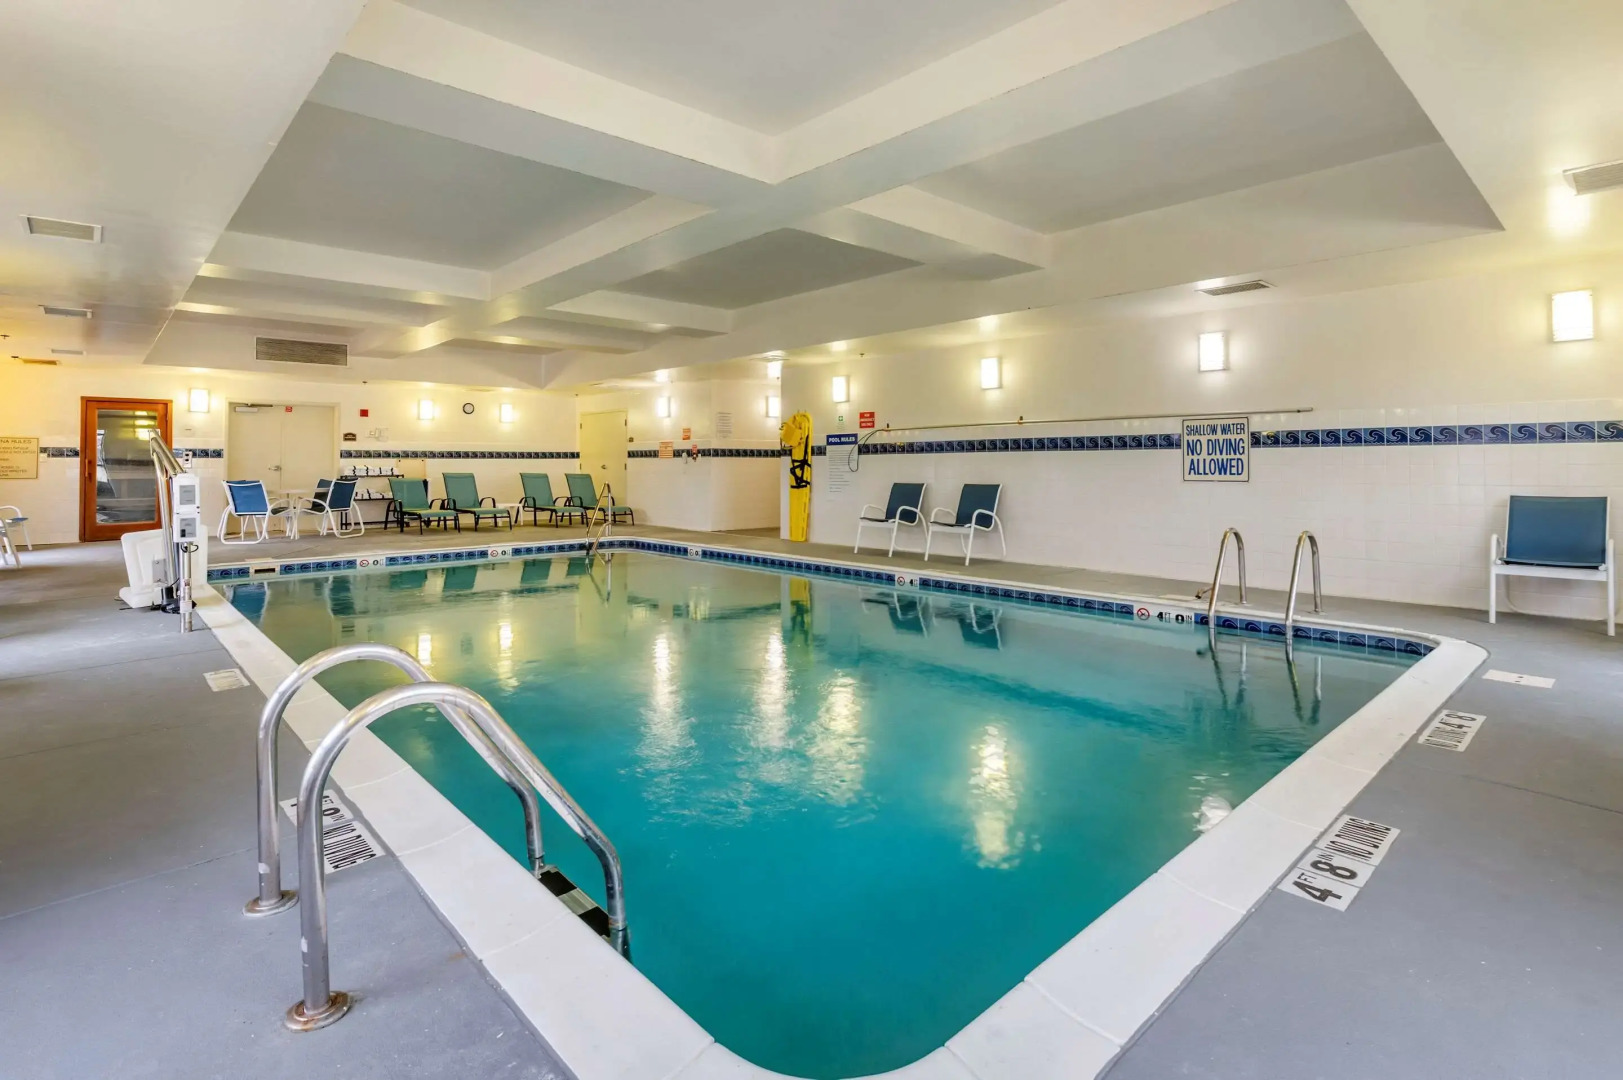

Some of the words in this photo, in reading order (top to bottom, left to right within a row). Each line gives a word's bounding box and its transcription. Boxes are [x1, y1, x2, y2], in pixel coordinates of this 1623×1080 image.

[1186, 424, 1218, 436] SHALLOW
[1220, 423, 1245, 435] WATER
[1187, 439, 1202, 456] NO
[1207, 438, 1245, 456] DIVING
[1188, 458, 1244, 475] ALLOWED
[1334, 818, 1391, 849] DIVING
[324, 834, 376, 870] DIVING
[1324, 840, 1374, 861] NO
[1310, 860, 1358, 880] 8
[1292, 880, 1343, 902] 4
